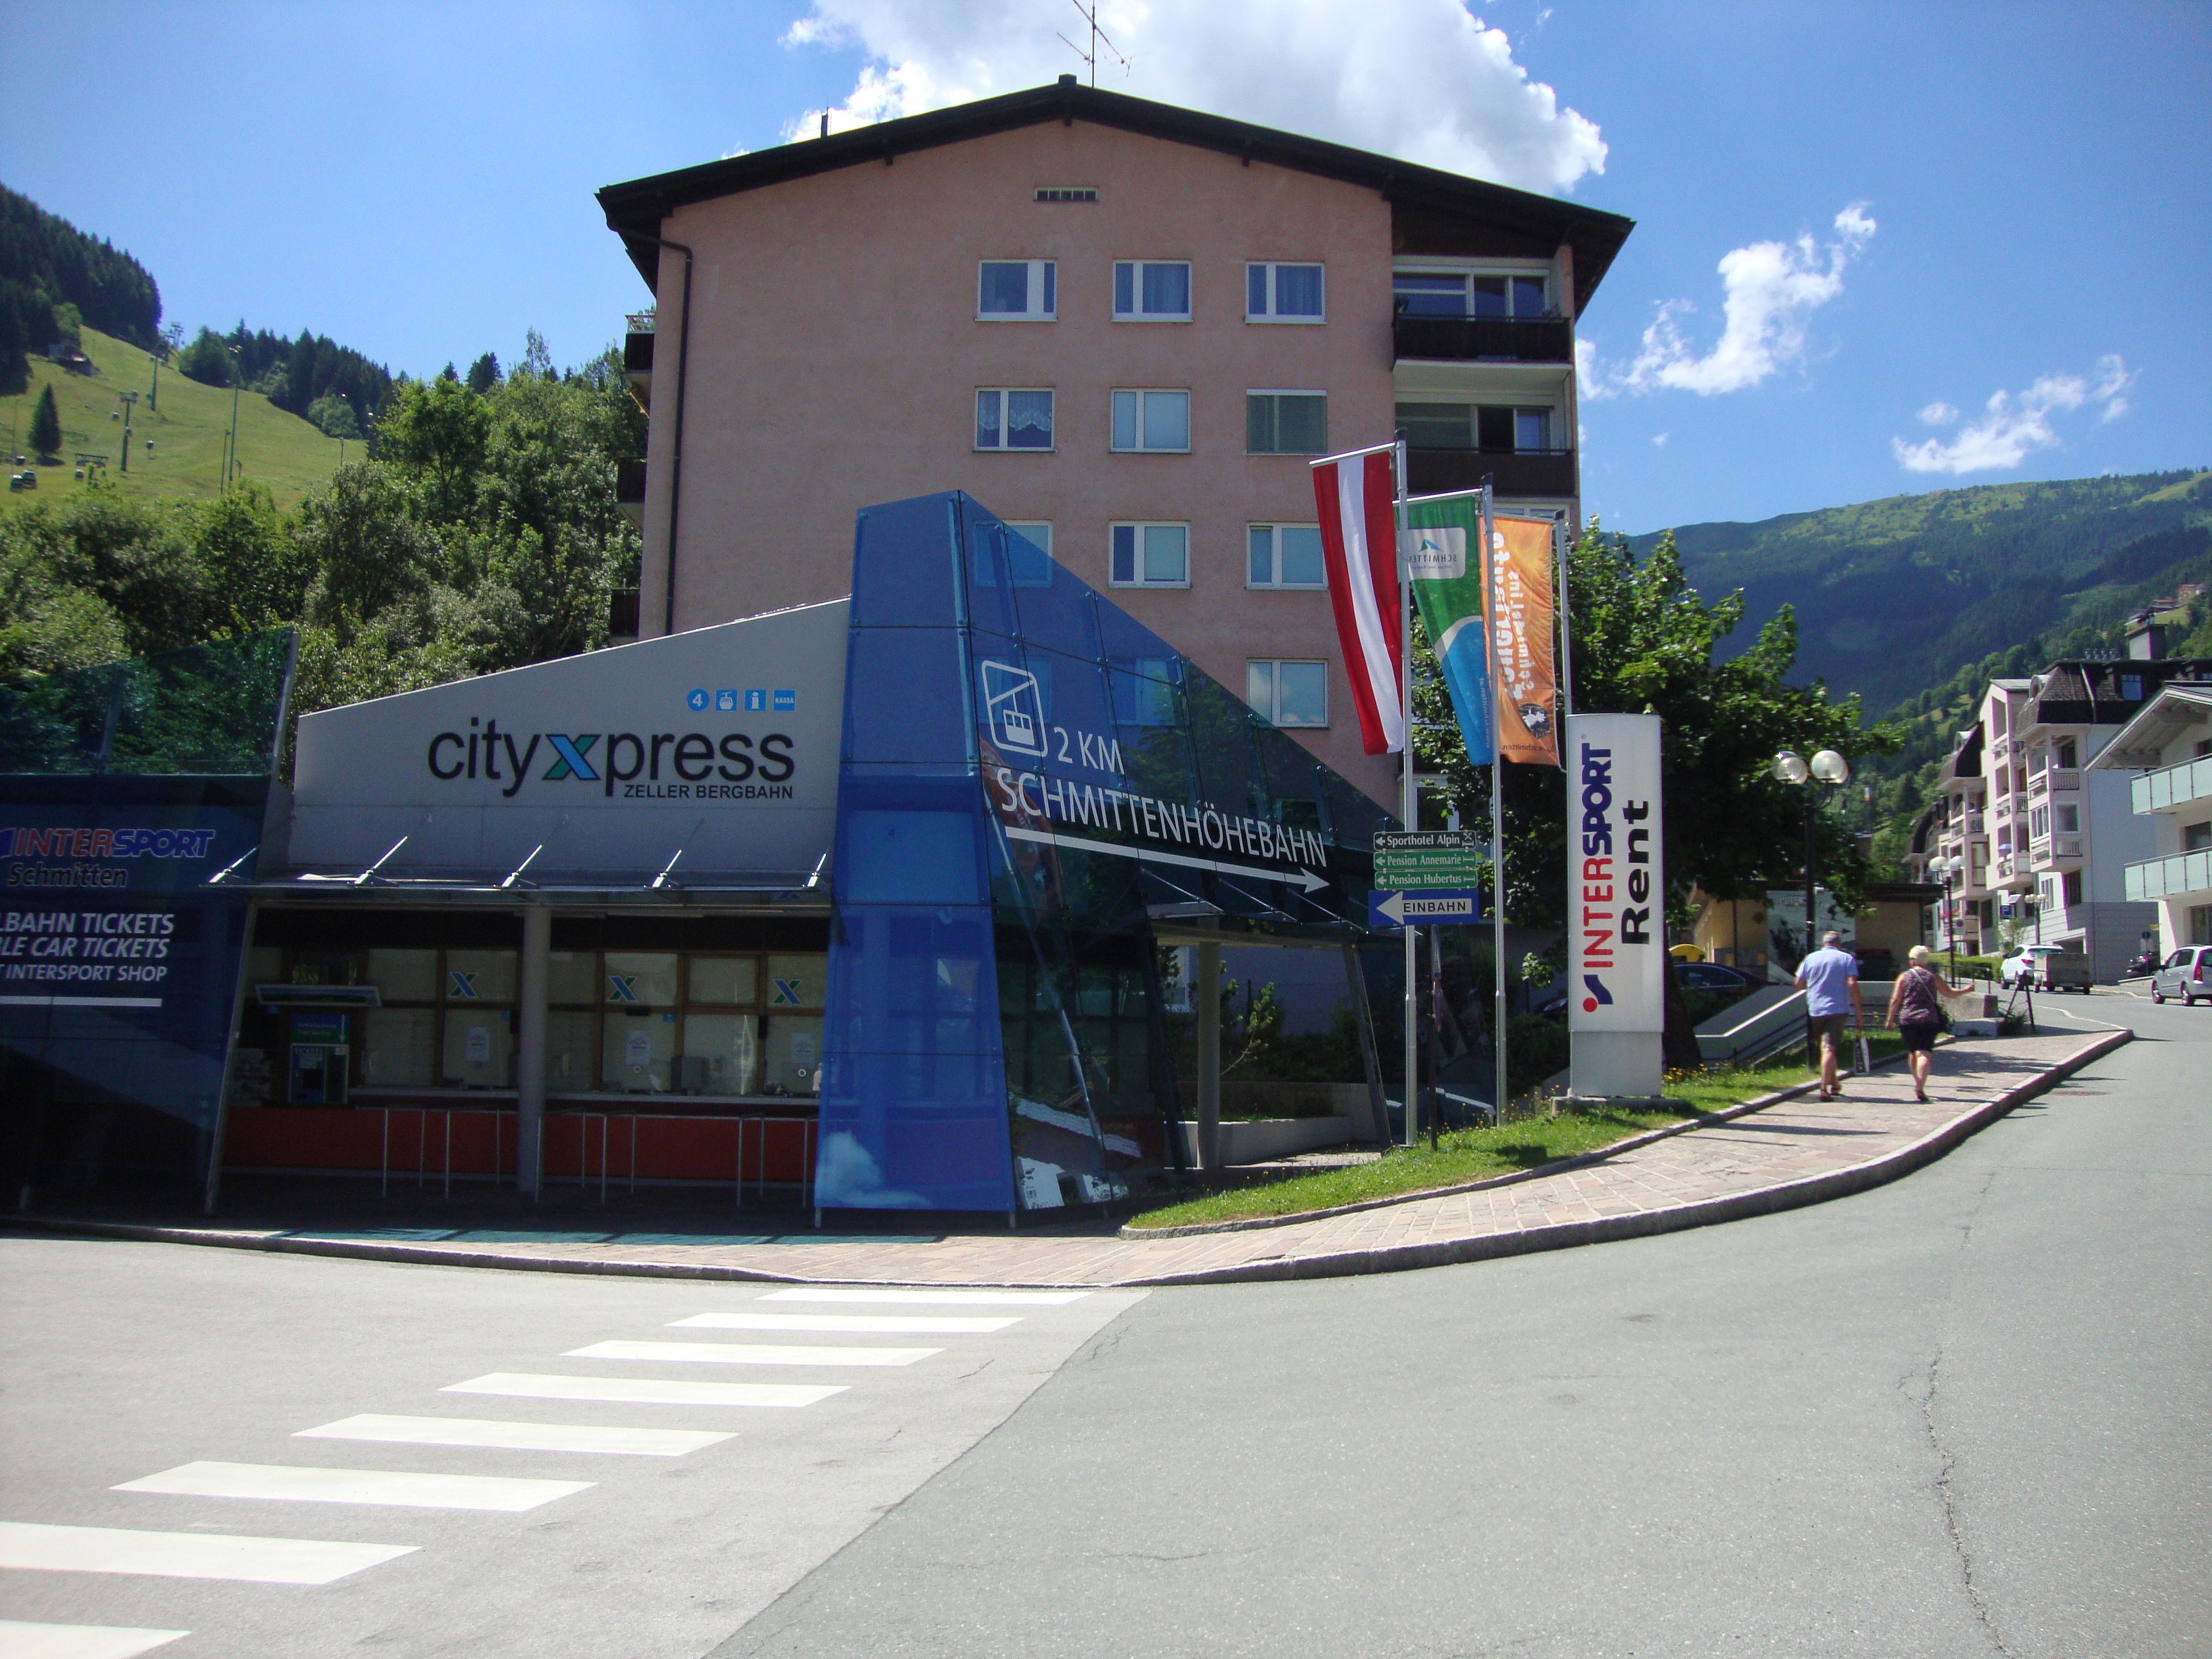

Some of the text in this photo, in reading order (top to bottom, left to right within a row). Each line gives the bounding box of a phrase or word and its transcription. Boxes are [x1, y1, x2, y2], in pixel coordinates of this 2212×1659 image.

[692, 693, 703, 707] 4
[427, 717, 796, 798] cityxpress
[1053, 726, 1125, 775] 2 KM
[624, 784, 793, 800] ZELLER BERGBAHN
[997, 767, 1327, 868] SCHMITTENHÖHEBAHN
[14, 828, 216, 858] INTERSPORT
[1387, 834, 1460, 847] Sporthotel Alpin
[1387, 853, 1462, 866] Pension Annemarie
[1582, 742, 1613, 968] INTERSPORT
[6, 861, 128, 888] Schmitten
[1389, 873, 1462, 885] Pension Hubertus
[1621, 798, 1650, 945] Rent
[1403, 901, 1466, 913] EINBAHN
[81, 912, 175, 935] TICKETS
[29, 936, 79, 957] CAR
[82, 937, 171, 959] TICKETS
[5, 964, 115, 982] INTERSPORT
[116, 965, 168, 982] SHOP
